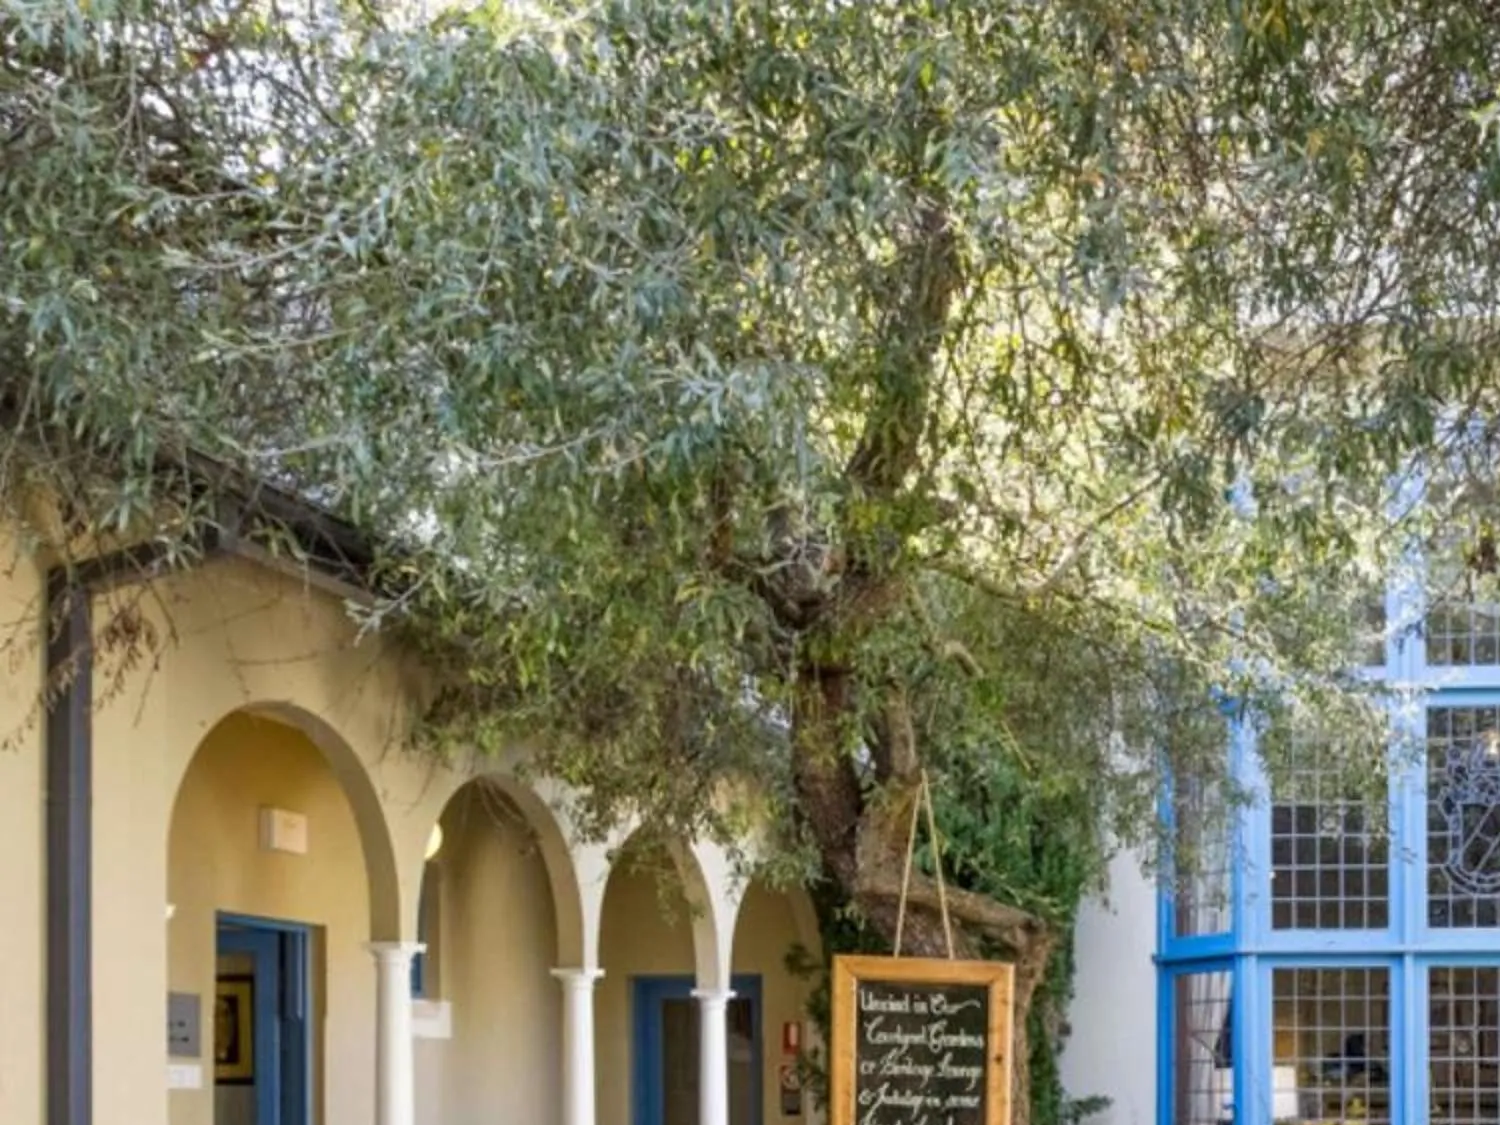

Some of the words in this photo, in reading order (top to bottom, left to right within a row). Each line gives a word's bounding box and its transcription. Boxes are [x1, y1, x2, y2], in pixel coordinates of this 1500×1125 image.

[861, 988, 910, 1013] Unwind
[913, 993, 929, 1014] in
[864, 1016, 928, 1054] Courtyard
[860, 1060, 877, 1076] or
[925, 1089, 942, 1107] in
